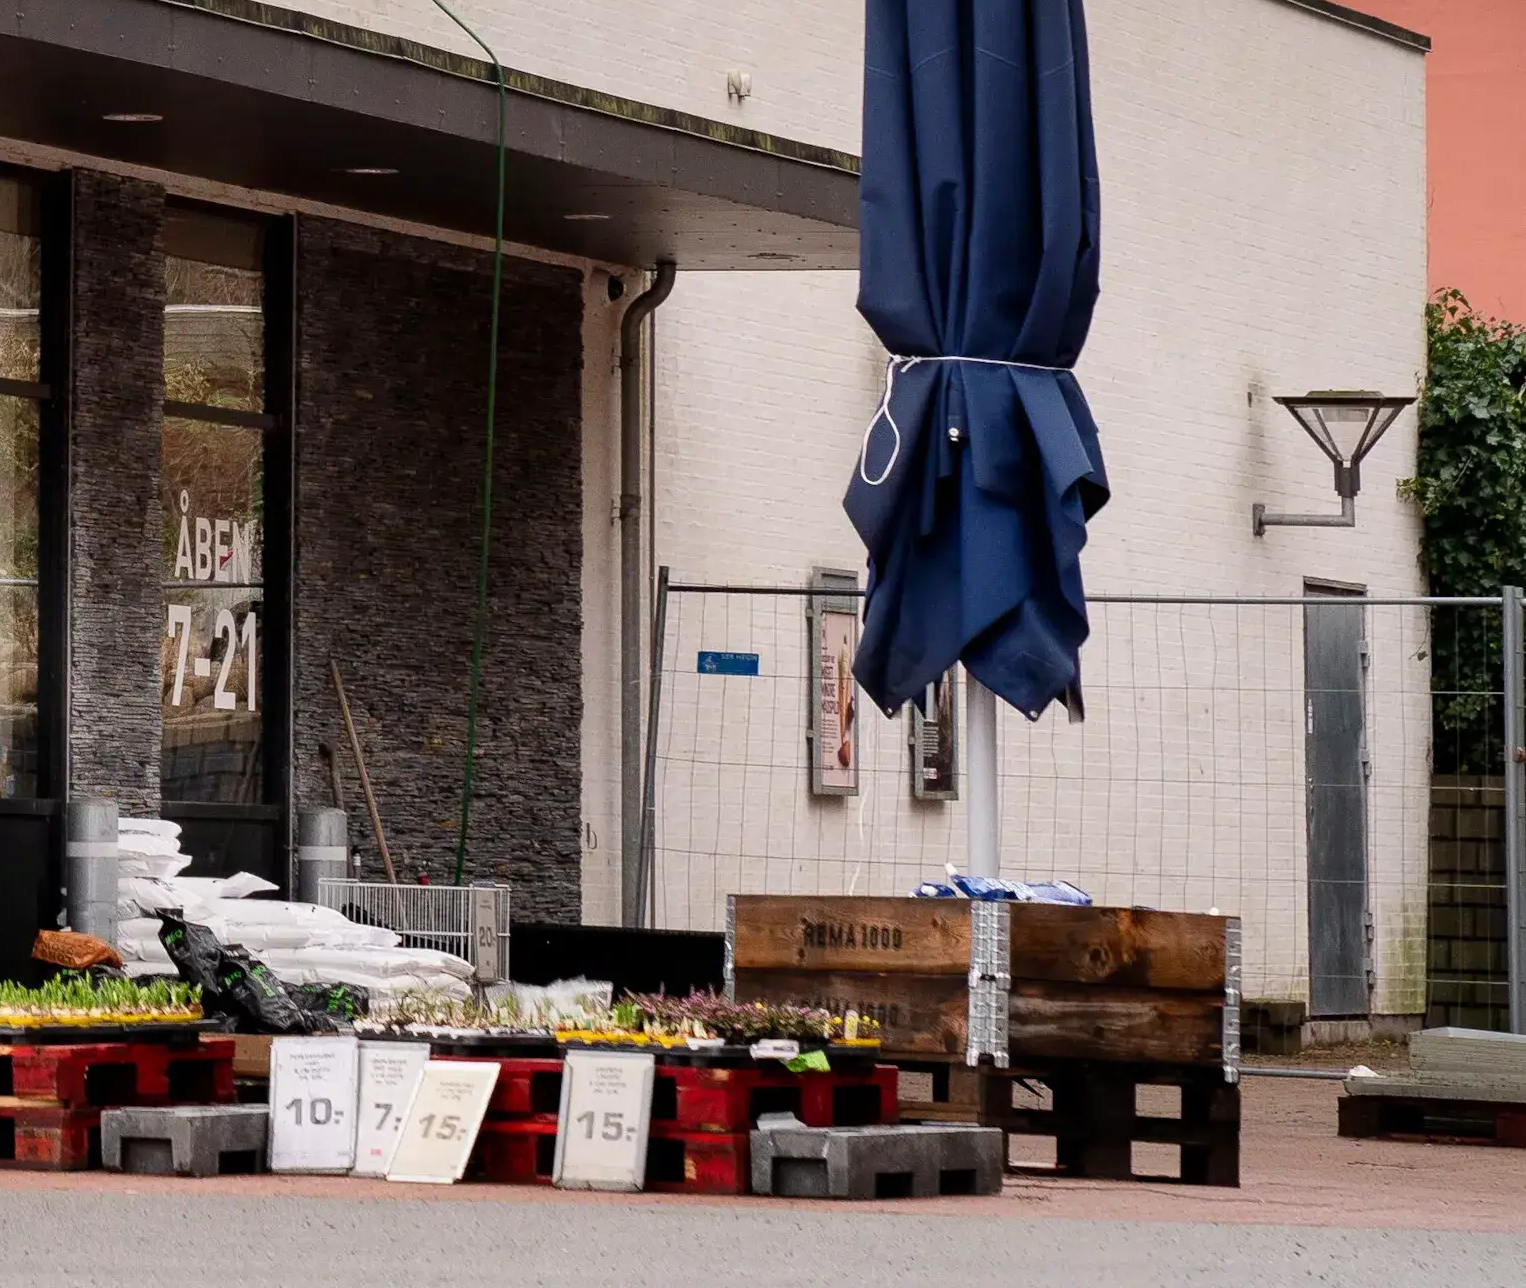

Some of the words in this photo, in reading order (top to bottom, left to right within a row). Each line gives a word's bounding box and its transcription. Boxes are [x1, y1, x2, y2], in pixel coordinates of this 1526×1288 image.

[174, 489, 252, 584] ÅBEN
[167, 604, 256, 712] 7-21
[861, 922, 902, 951] 1000
